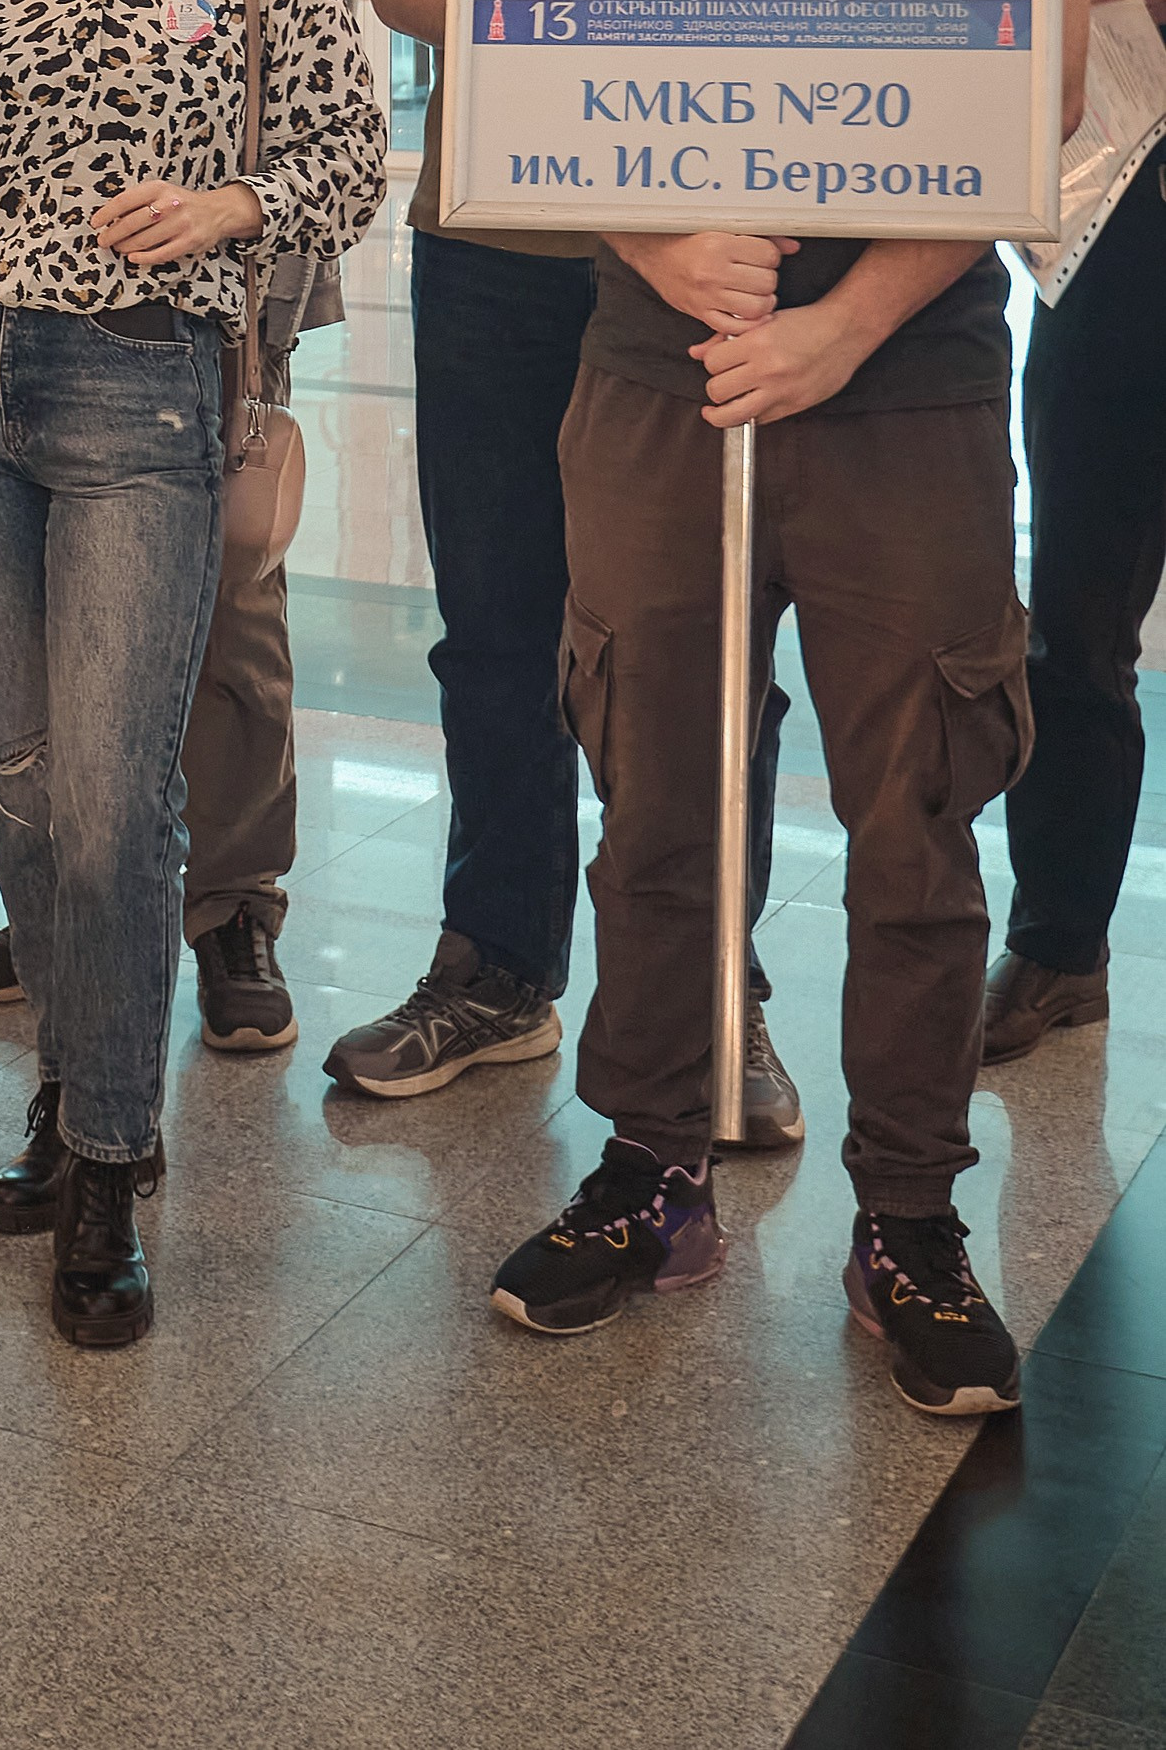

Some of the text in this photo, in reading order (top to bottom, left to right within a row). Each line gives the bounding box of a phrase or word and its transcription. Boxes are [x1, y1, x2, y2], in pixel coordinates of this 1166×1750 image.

[528, 1, 577, 41] 13
[588, 0, 969, 18] ОТКРЫТЫЙ ШАХМАТНЫЙ ФЕСТИВАЛЬ
[587, 19, 674, 31] РАБОТНИКОВ
[682, 20, 809, 32] ЗДРАВООХРАНЕНИЯ
[816, 22, 926, 33] КРАСНОЯРСКОГО
[587, 32, 968, 45] ПАМЯТИ ЗАСЛУЖЕННОГО ВРАЧА РФ АЛЬБЕРТА КРЫЖАНОВСКОГО
[580, 79, 912, 128] КМКБ №20
[508, 144, 984, 204] им. И.С. Берзона
